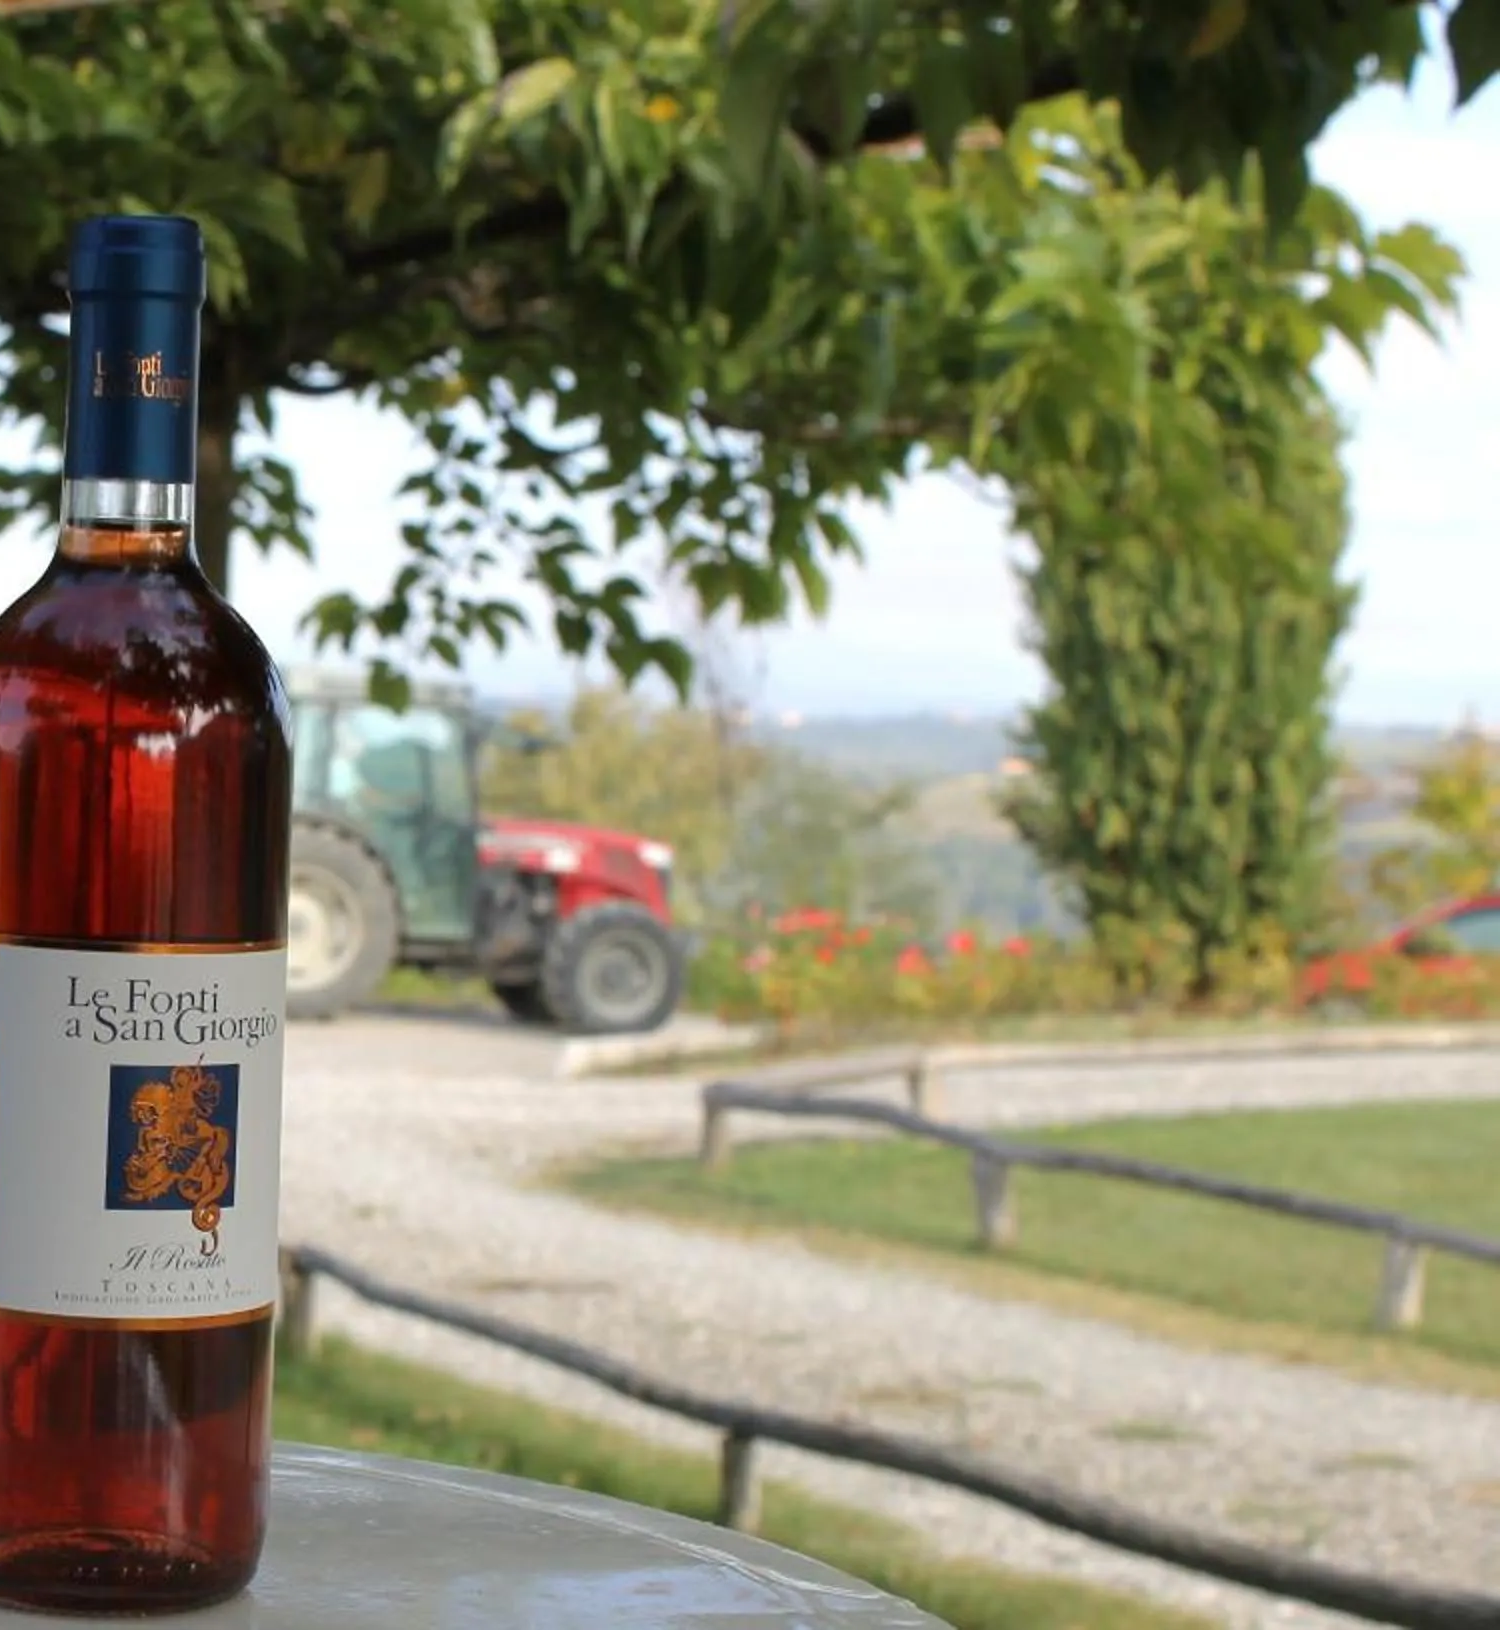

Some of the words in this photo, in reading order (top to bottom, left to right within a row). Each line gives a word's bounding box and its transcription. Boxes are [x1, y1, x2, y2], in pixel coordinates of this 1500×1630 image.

[67, 975, 110, 1008] Le
[125, 978, 220, 1015] Fonti
[64, 1016, 83, 1039] a
[93, 1005, 165, 1045] San
[174, 1006, 278, 1048] Giorgio
[101, 1277, 233, 1294] TOSCANA
